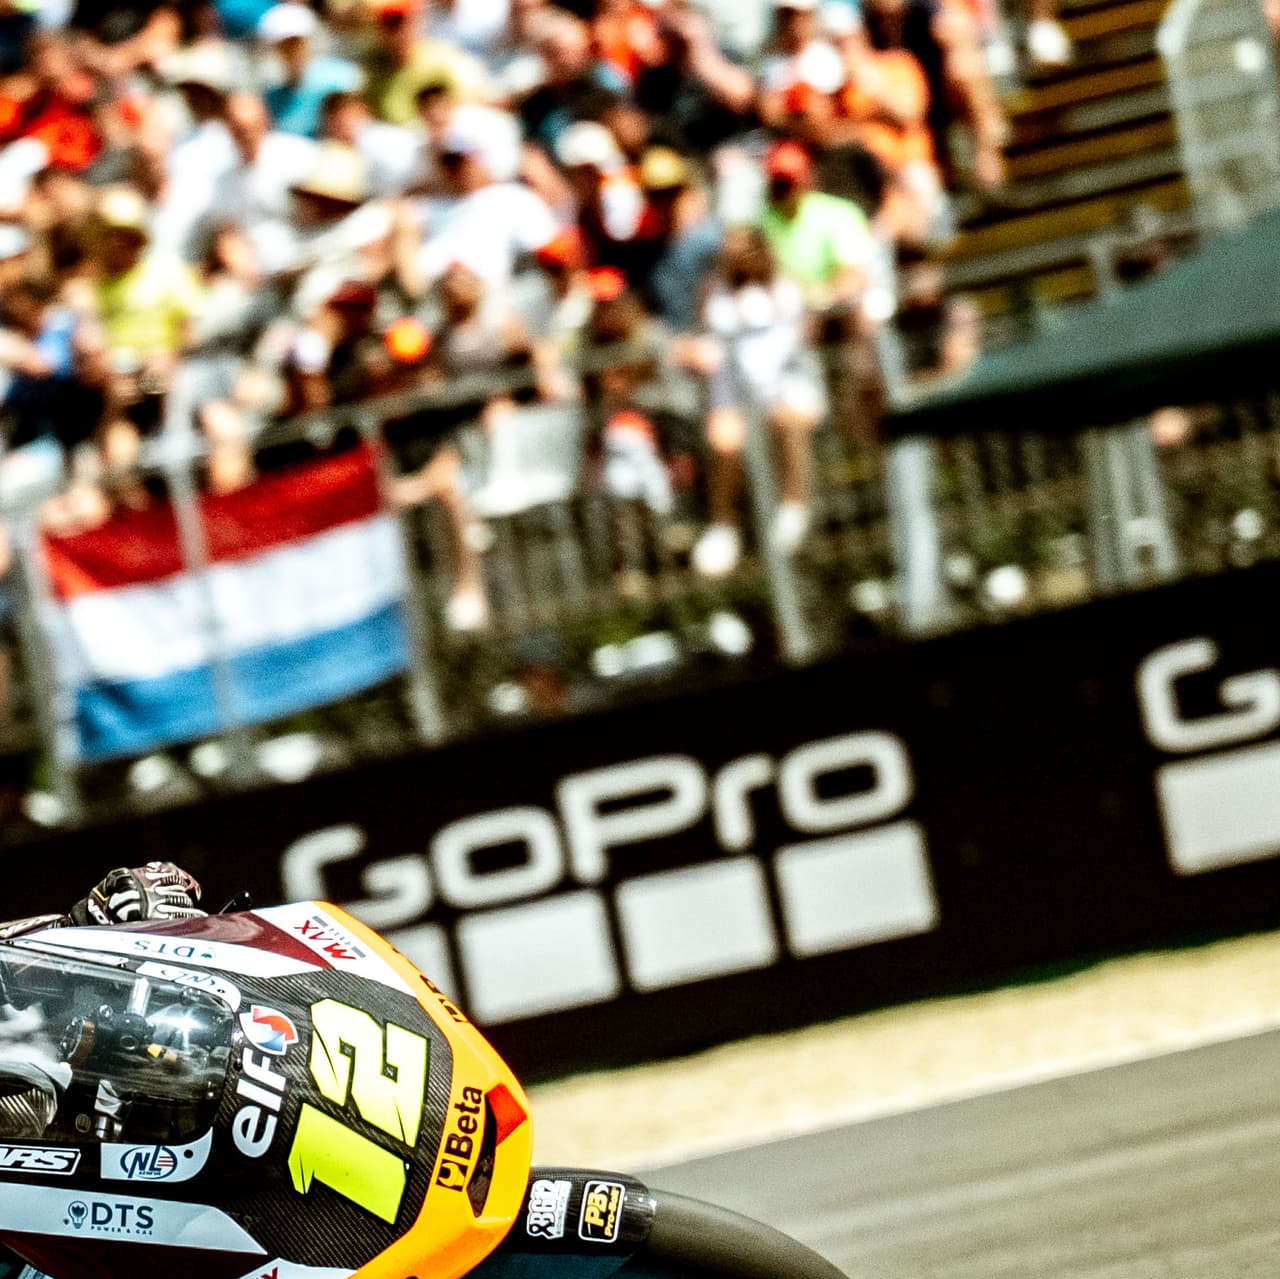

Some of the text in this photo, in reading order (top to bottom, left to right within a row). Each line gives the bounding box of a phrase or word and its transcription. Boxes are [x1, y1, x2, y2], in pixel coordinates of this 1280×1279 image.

[281, 730, 915, 928] GoPro
[288, 998, 429, 1225] 12
[446, 1085, 483, 1160] Beta
[90, 1201, 154, 1229] DTS
[584, 1191, 609, 1228] PB
